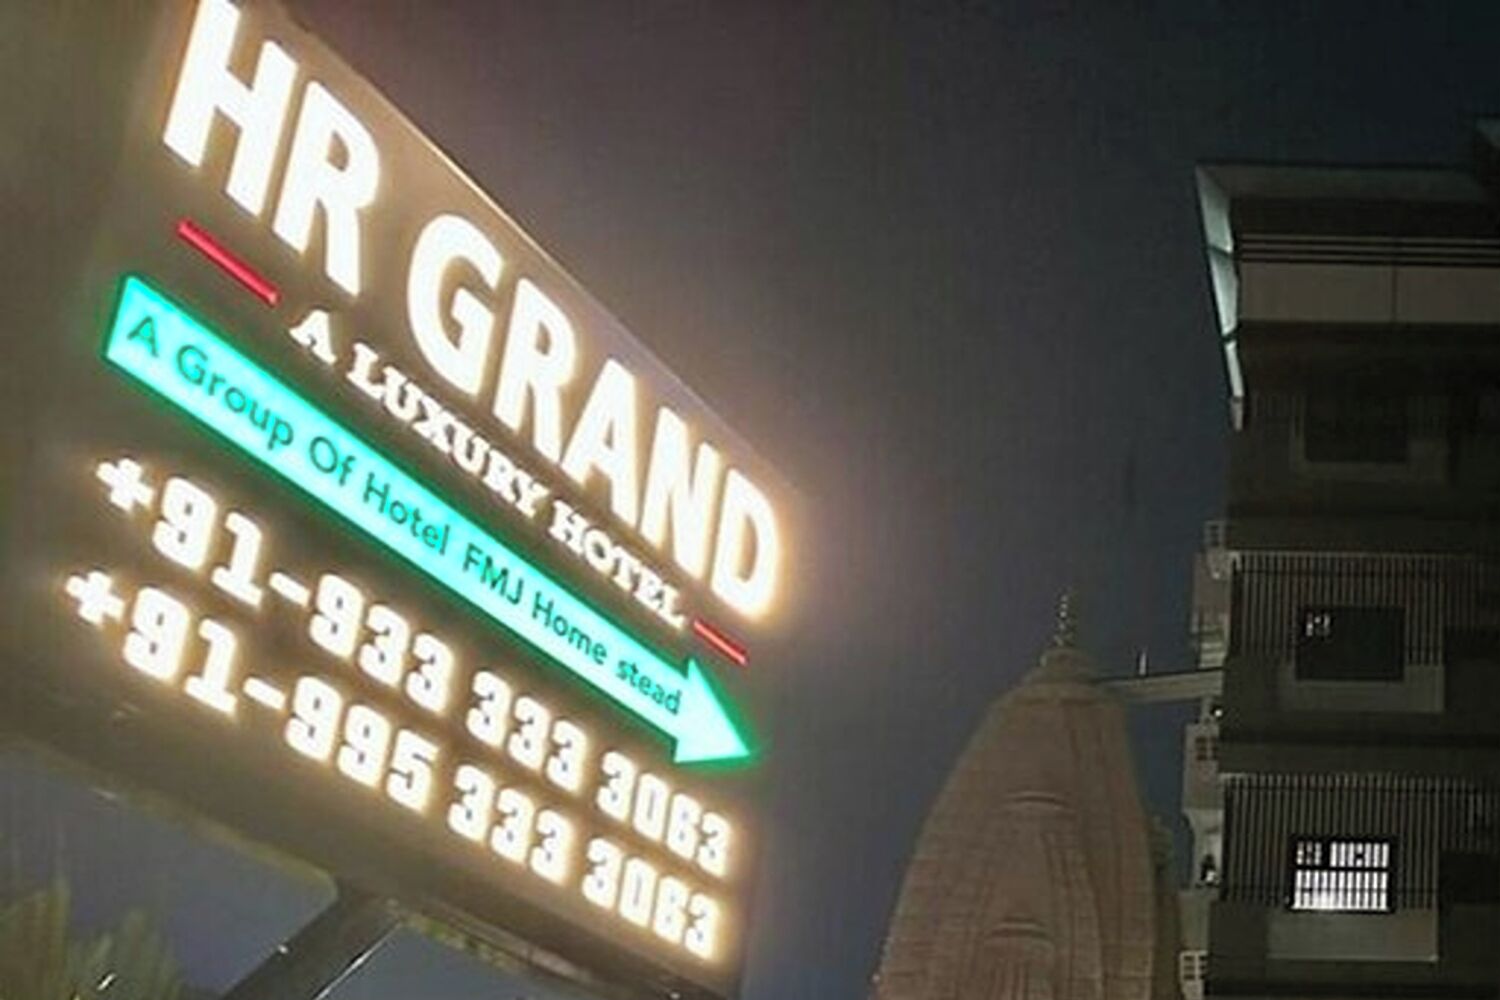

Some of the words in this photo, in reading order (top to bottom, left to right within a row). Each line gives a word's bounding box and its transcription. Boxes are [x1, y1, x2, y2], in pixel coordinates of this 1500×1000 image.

[164, 0, 380, 297] HR
[406, 214, 779, 619] GRAND
[288, 308, 337, 366] A
[346, 342, 549, 519] LUXURY
[548, 499, 687, 632] HOTEL
[96, 457, 457, 715] +91-933
[466, 670, 588, 796] 333
[597, 750, 732, 878] 3063
[126, 315, 159, 358] A
[175, 343, 294, 450] Group
[308, 435, 357, 487] Of
[362, 471, 451, 556] Hotel
[462, 541, 525, 606] FMJ
[531, 591, 608, 666] Home
[616, 657, 683, 716] stead
[65, 570, 441, 814] +91-995
[447, 764, 575, 888] 333
[581, 837, 722, 961] 3063
